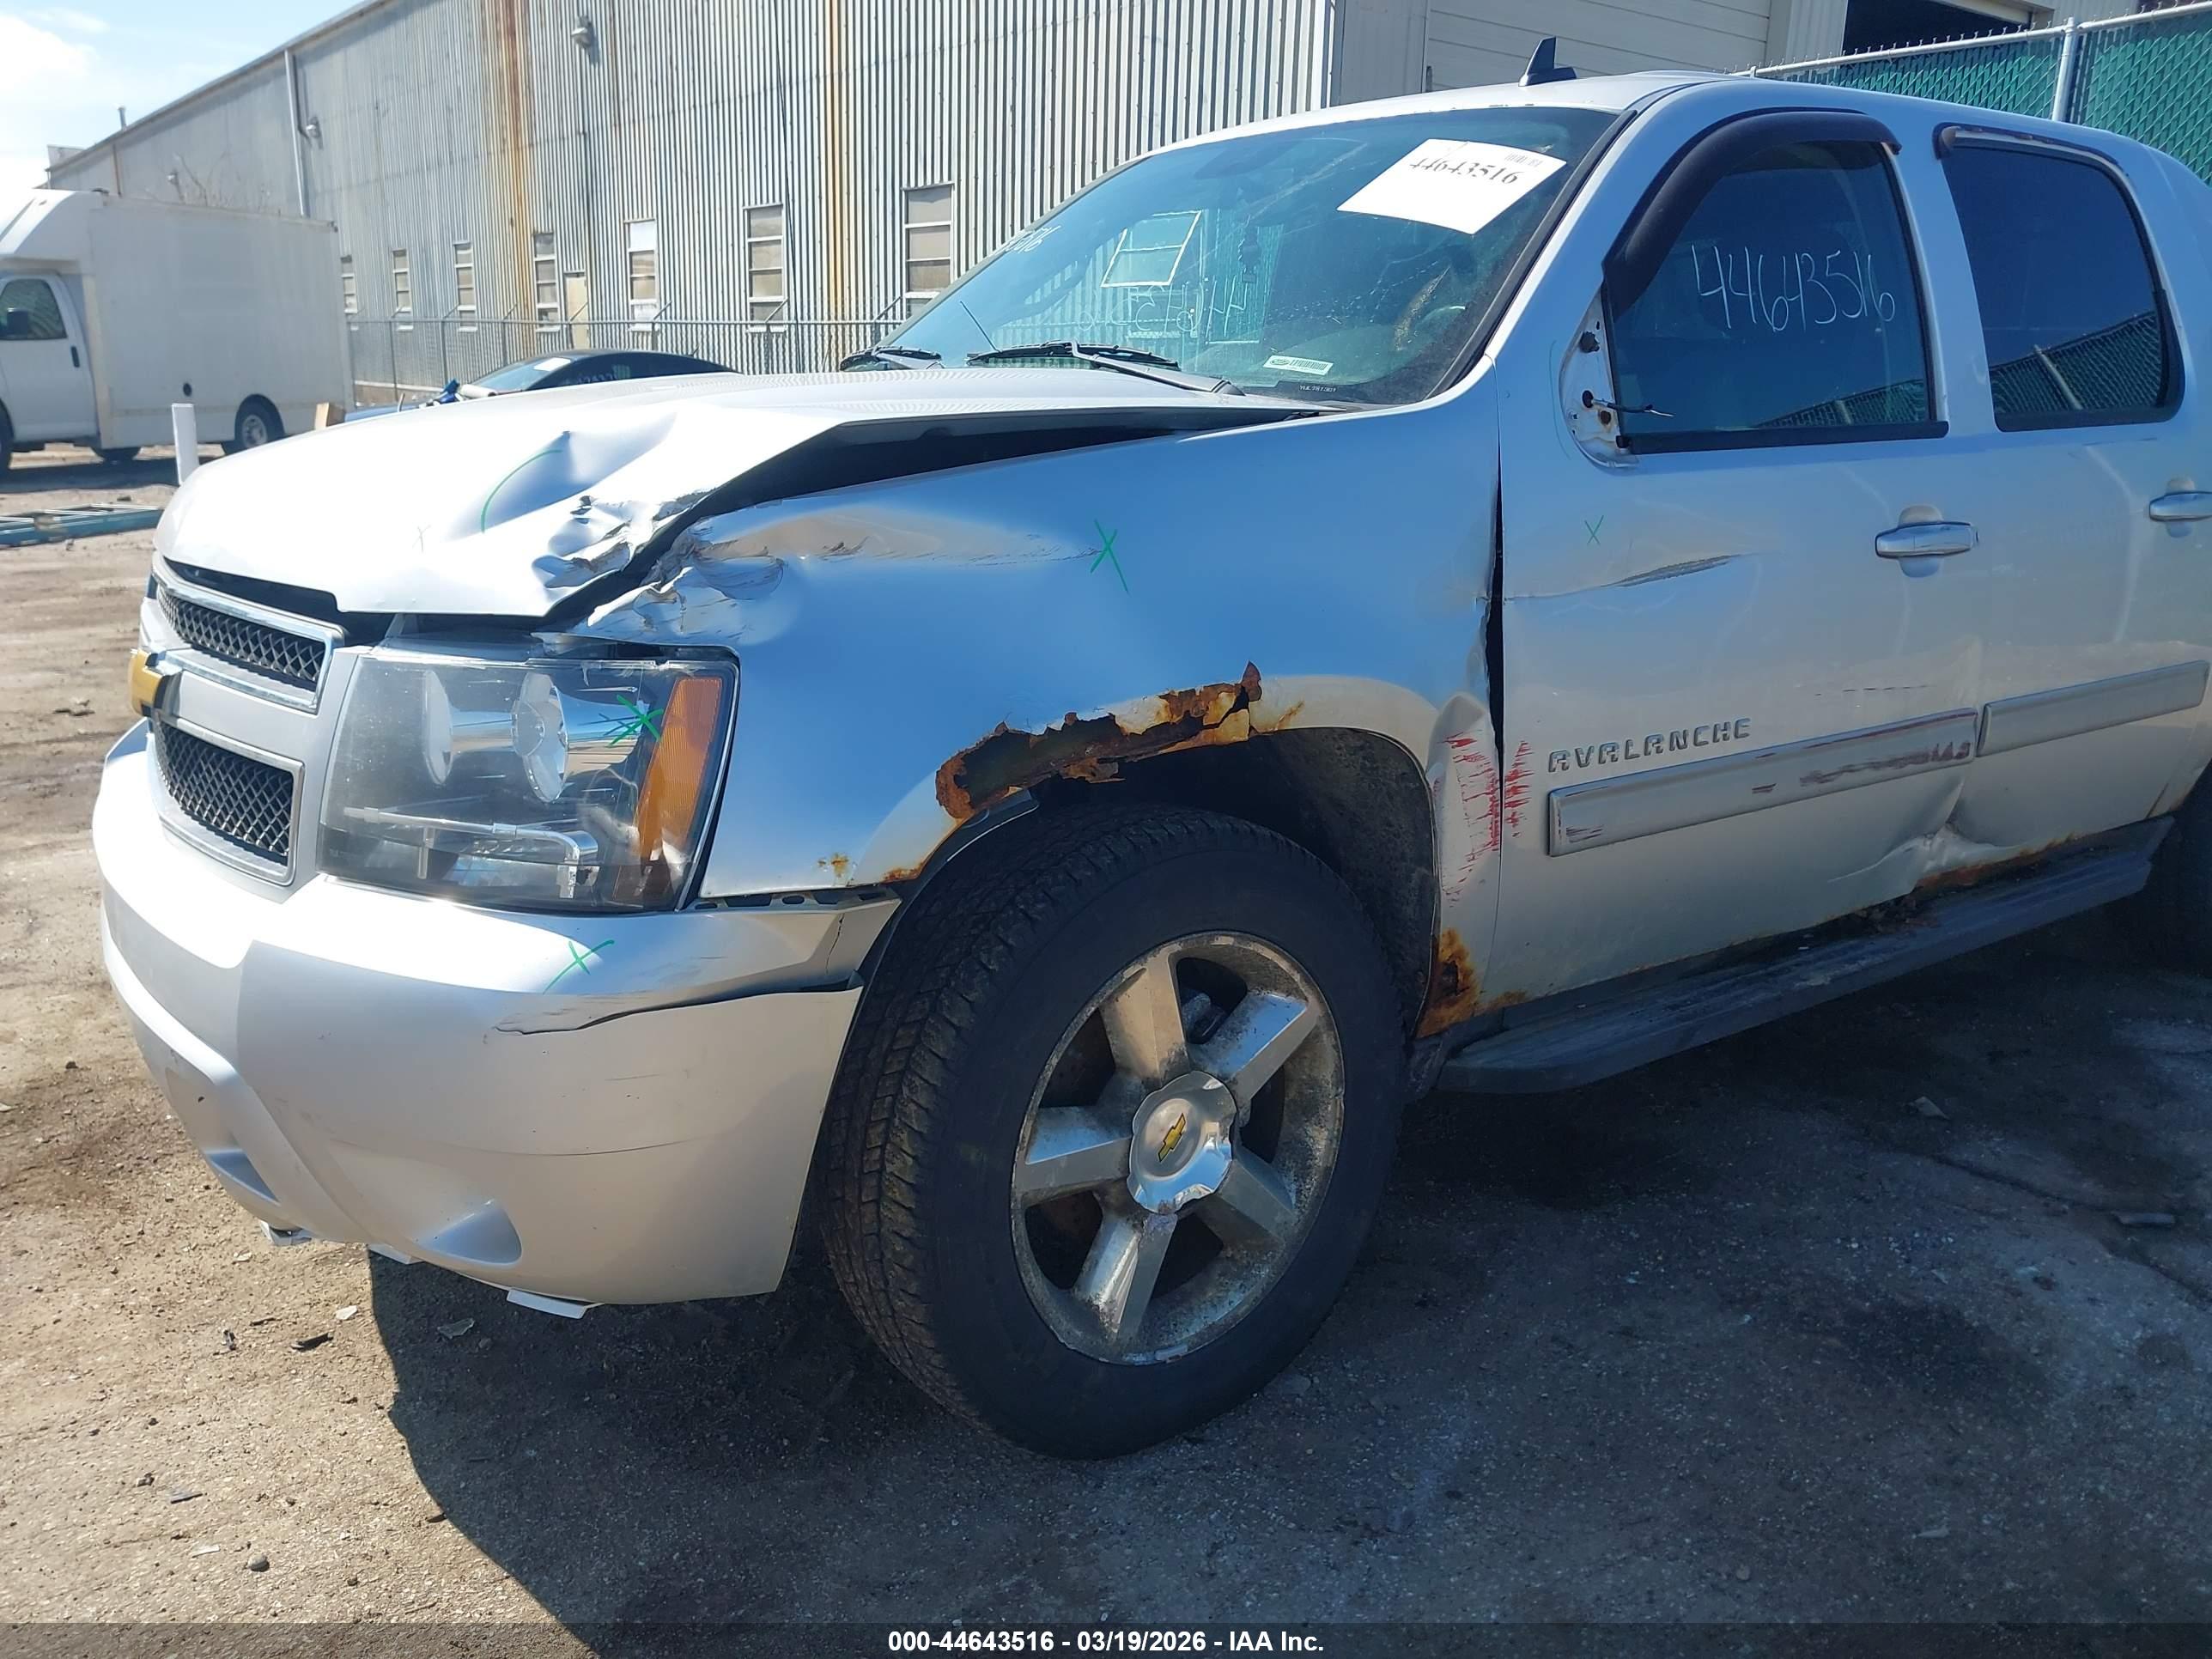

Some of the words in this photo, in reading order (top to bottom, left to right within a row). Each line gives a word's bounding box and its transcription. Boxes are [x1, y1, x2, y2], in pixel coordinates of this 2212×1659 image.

[1409, 157, 1525, 184] 44643516
[1691, 244, 1896, 333] 44643516
[1547, 717, 1752, 774] AVALANCHE
